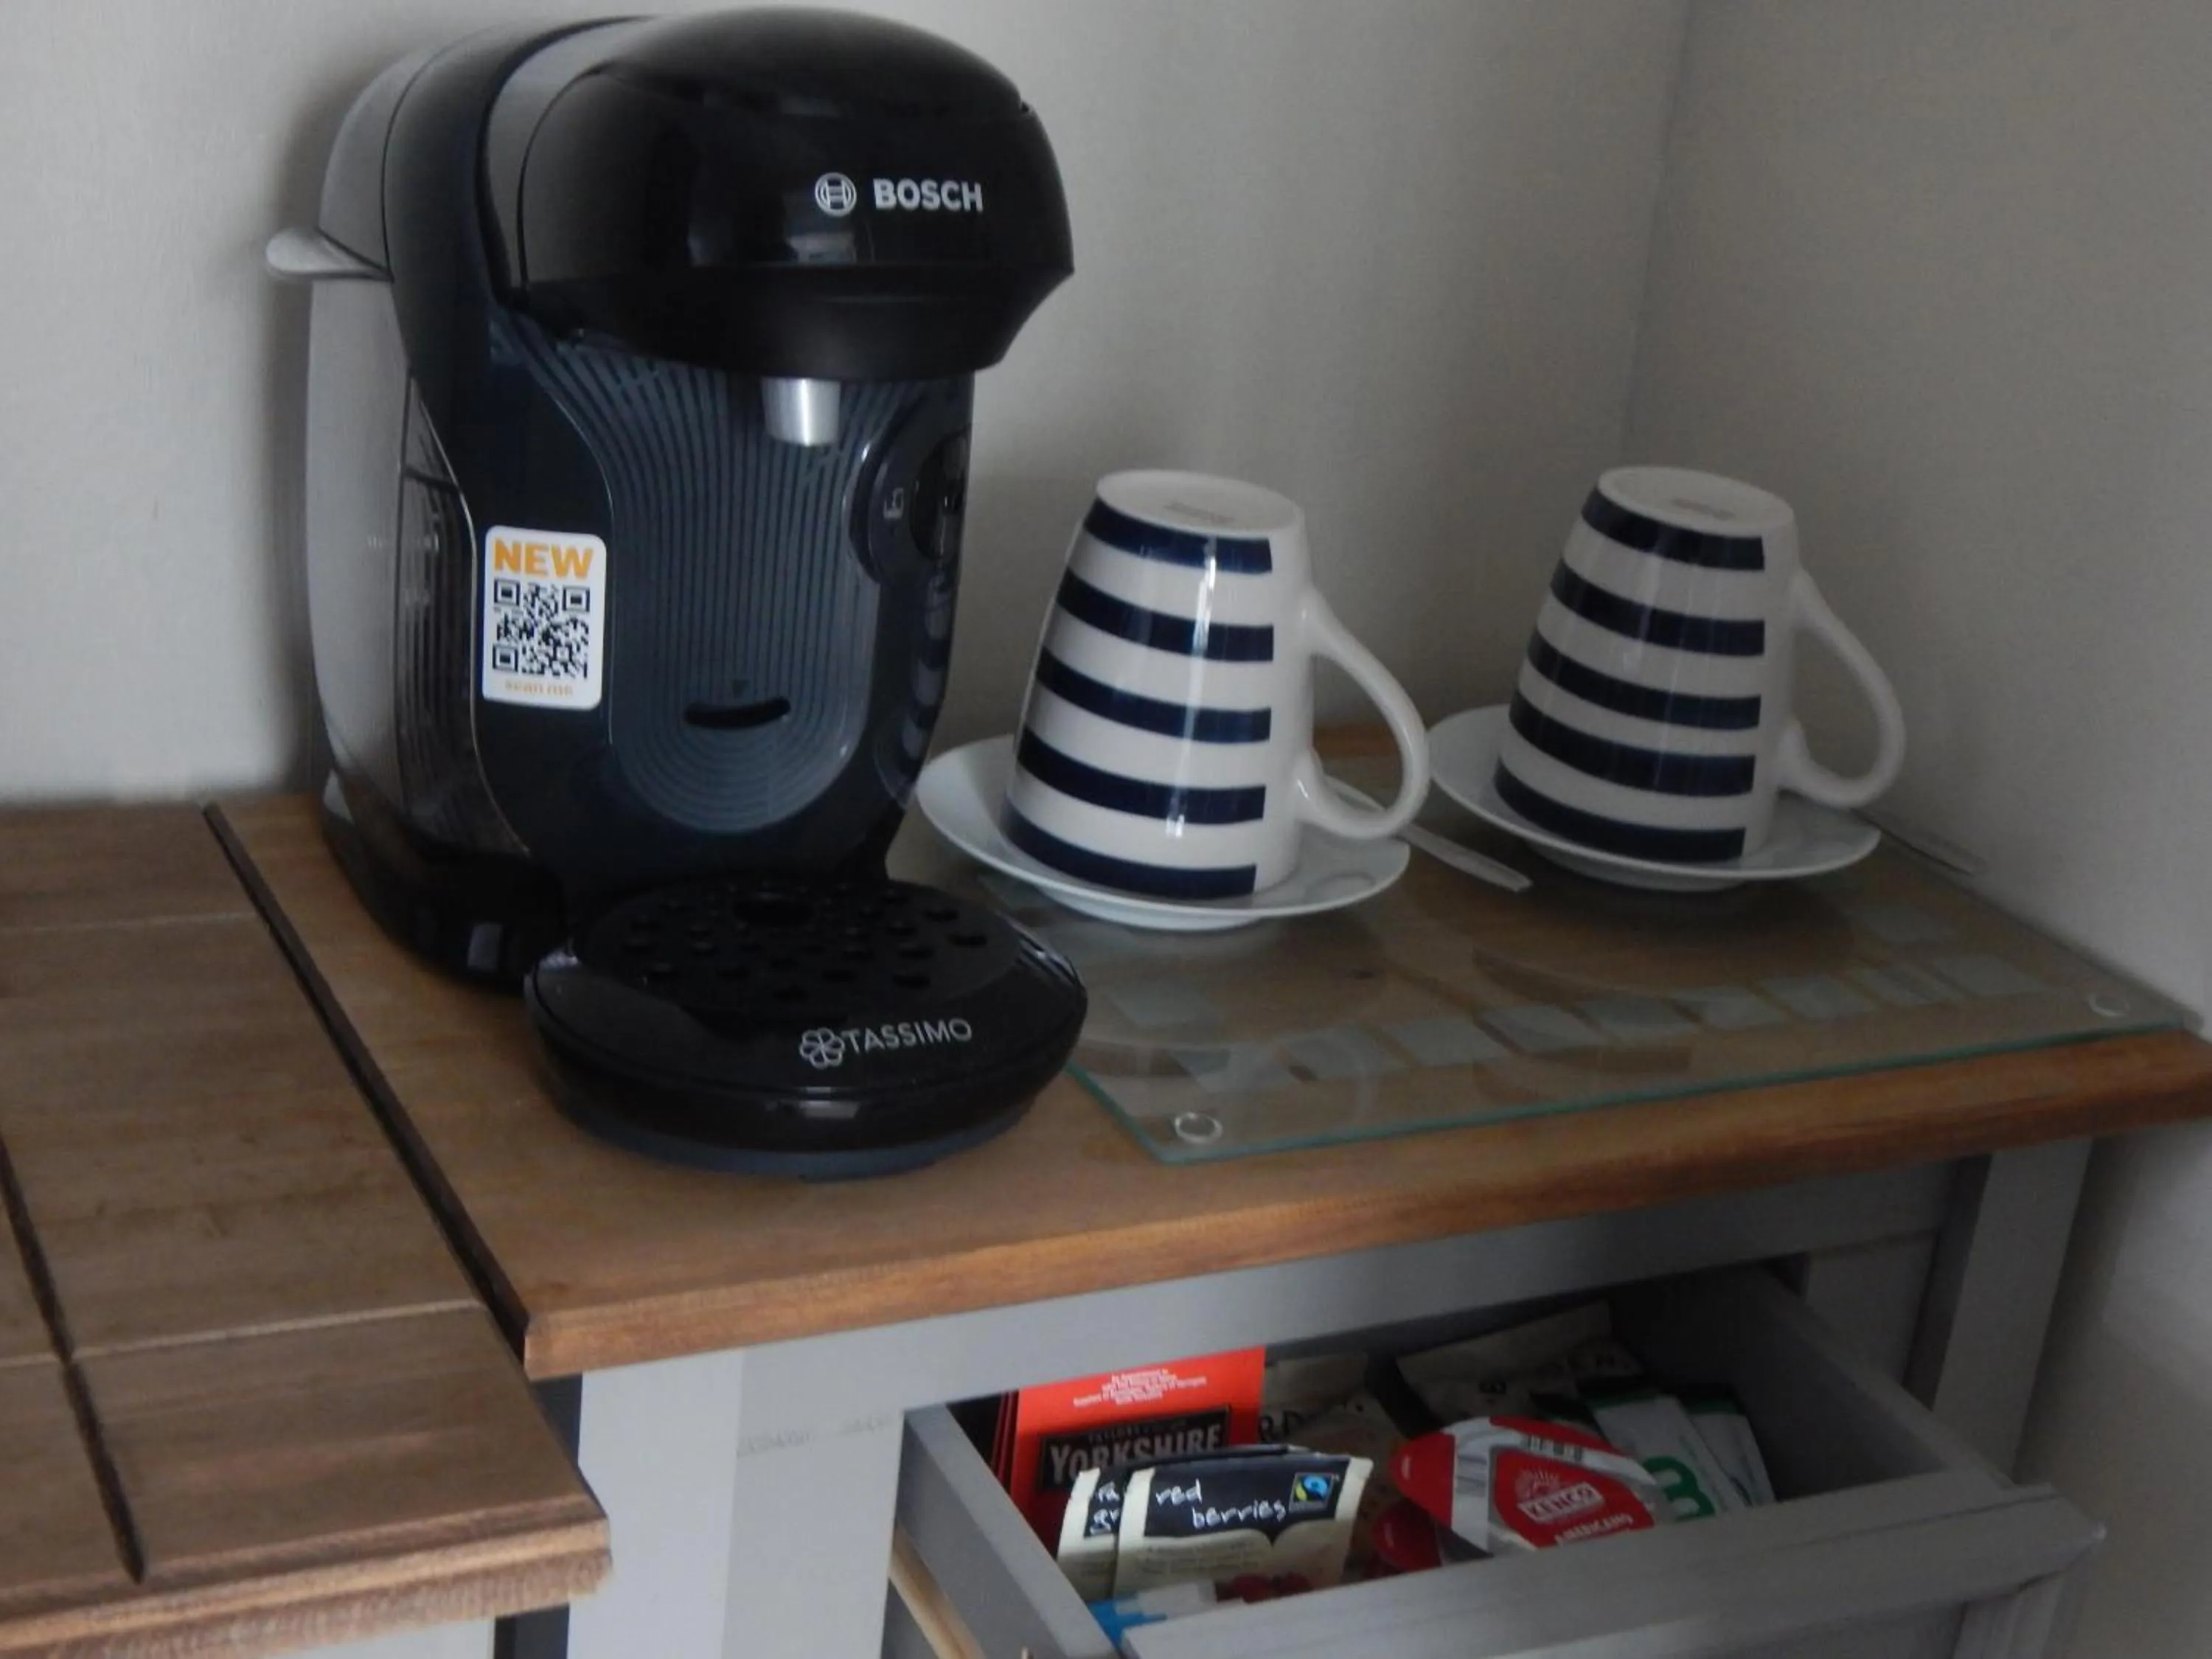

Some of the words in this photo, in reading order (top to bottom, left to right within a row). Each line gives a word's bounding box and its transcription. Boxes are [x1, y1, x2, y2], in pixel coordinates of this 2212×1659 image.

[873, 177, 983, 212] BOSCH
[494, 539, 594, 579] NEW
[841, 1018, 972, 1054] TASSIMO
[1049, 1422, 1223, 1485] YORKSHIRE
[1155, 1478, 1203, 1506] red
[1191, 1499, 1286, 1529] berries
